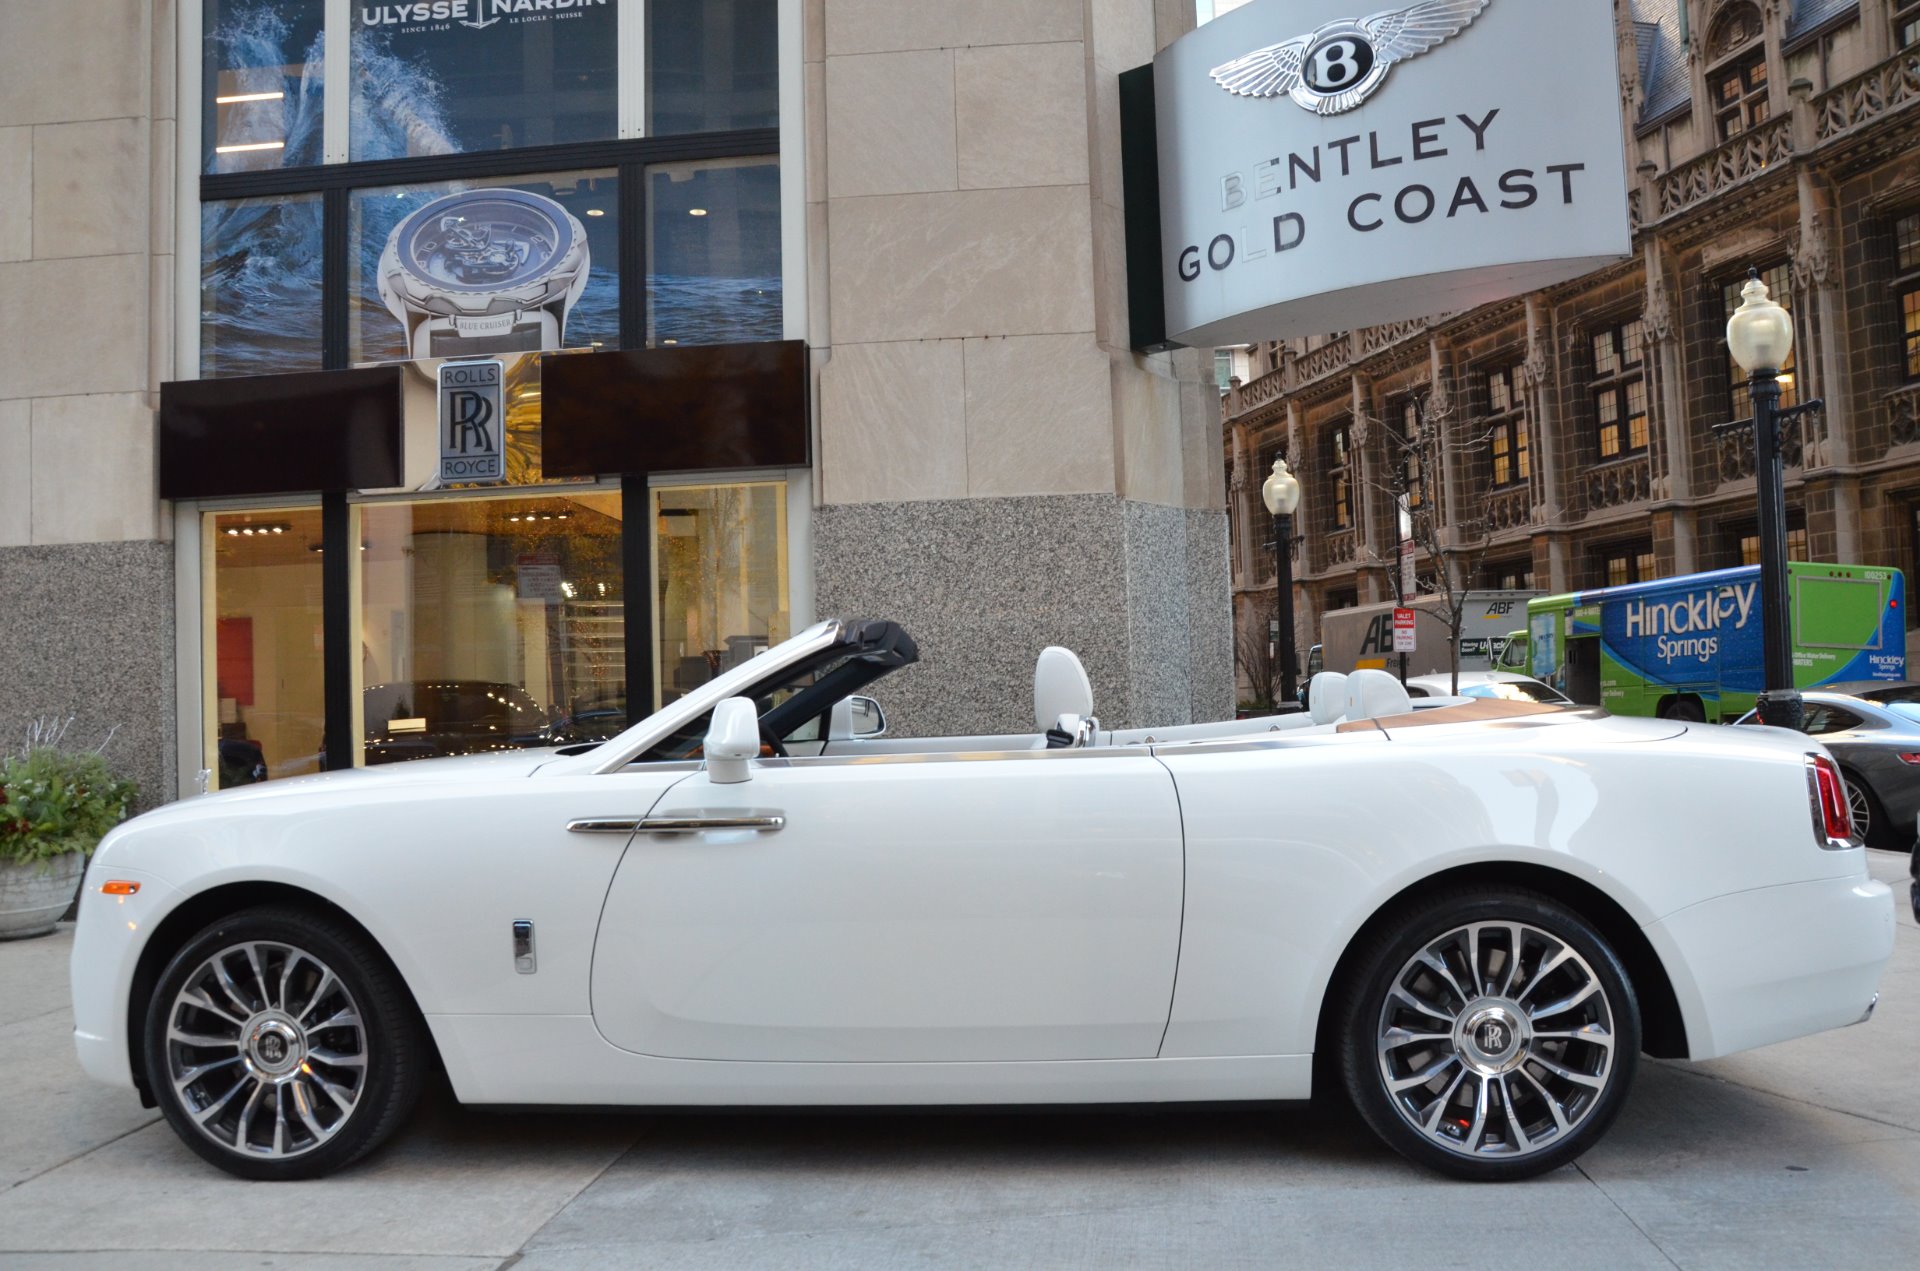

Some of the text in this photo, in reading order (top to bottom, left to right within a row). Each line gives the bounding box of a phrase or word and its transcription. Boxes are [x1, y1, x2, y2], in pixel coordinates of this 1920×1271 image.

[362, 0, 468, 26] ULYSSE
[401, 23, 450, 34] SINCE 1846
[1347, 163, 1585, 232] COAST
[460, 319, 511, 330] BLUE CRUISER
[445, 368, 495, 384] ROLLS
[445, 459, 496, 475] ROYCE
[1486, 602, 1515, 615] ABF
[1626, 582, 1757, 638] Hinckley
[1360, 613, 1393, 655] AB
[1657, 635, 1718, 665] Springs
[1869, 654, 1904, 668] Hinckley
